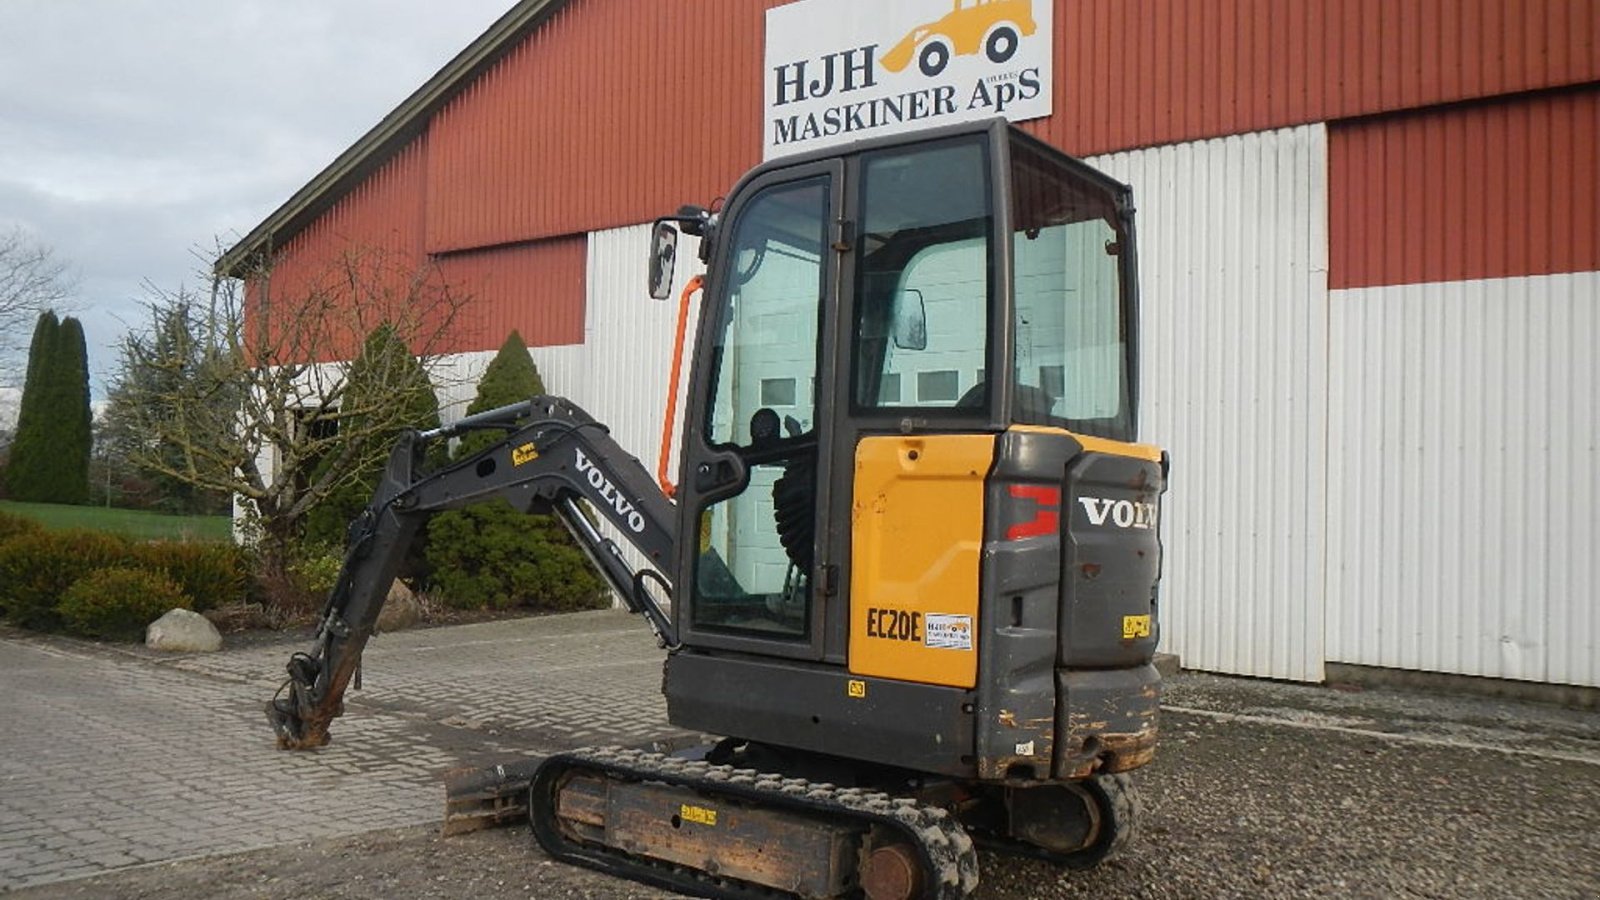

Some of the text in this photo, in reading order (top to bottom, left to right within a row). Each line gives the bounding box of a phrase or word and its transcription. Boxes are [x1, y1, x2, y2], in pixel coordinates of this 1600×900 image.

[773, 44, 879, 106] HJH
[773, 67, 1040, 145] MASKINER ApS
[575, 448, 645, 532] VOLVO
[867, 608, 921, 642] EC20E
